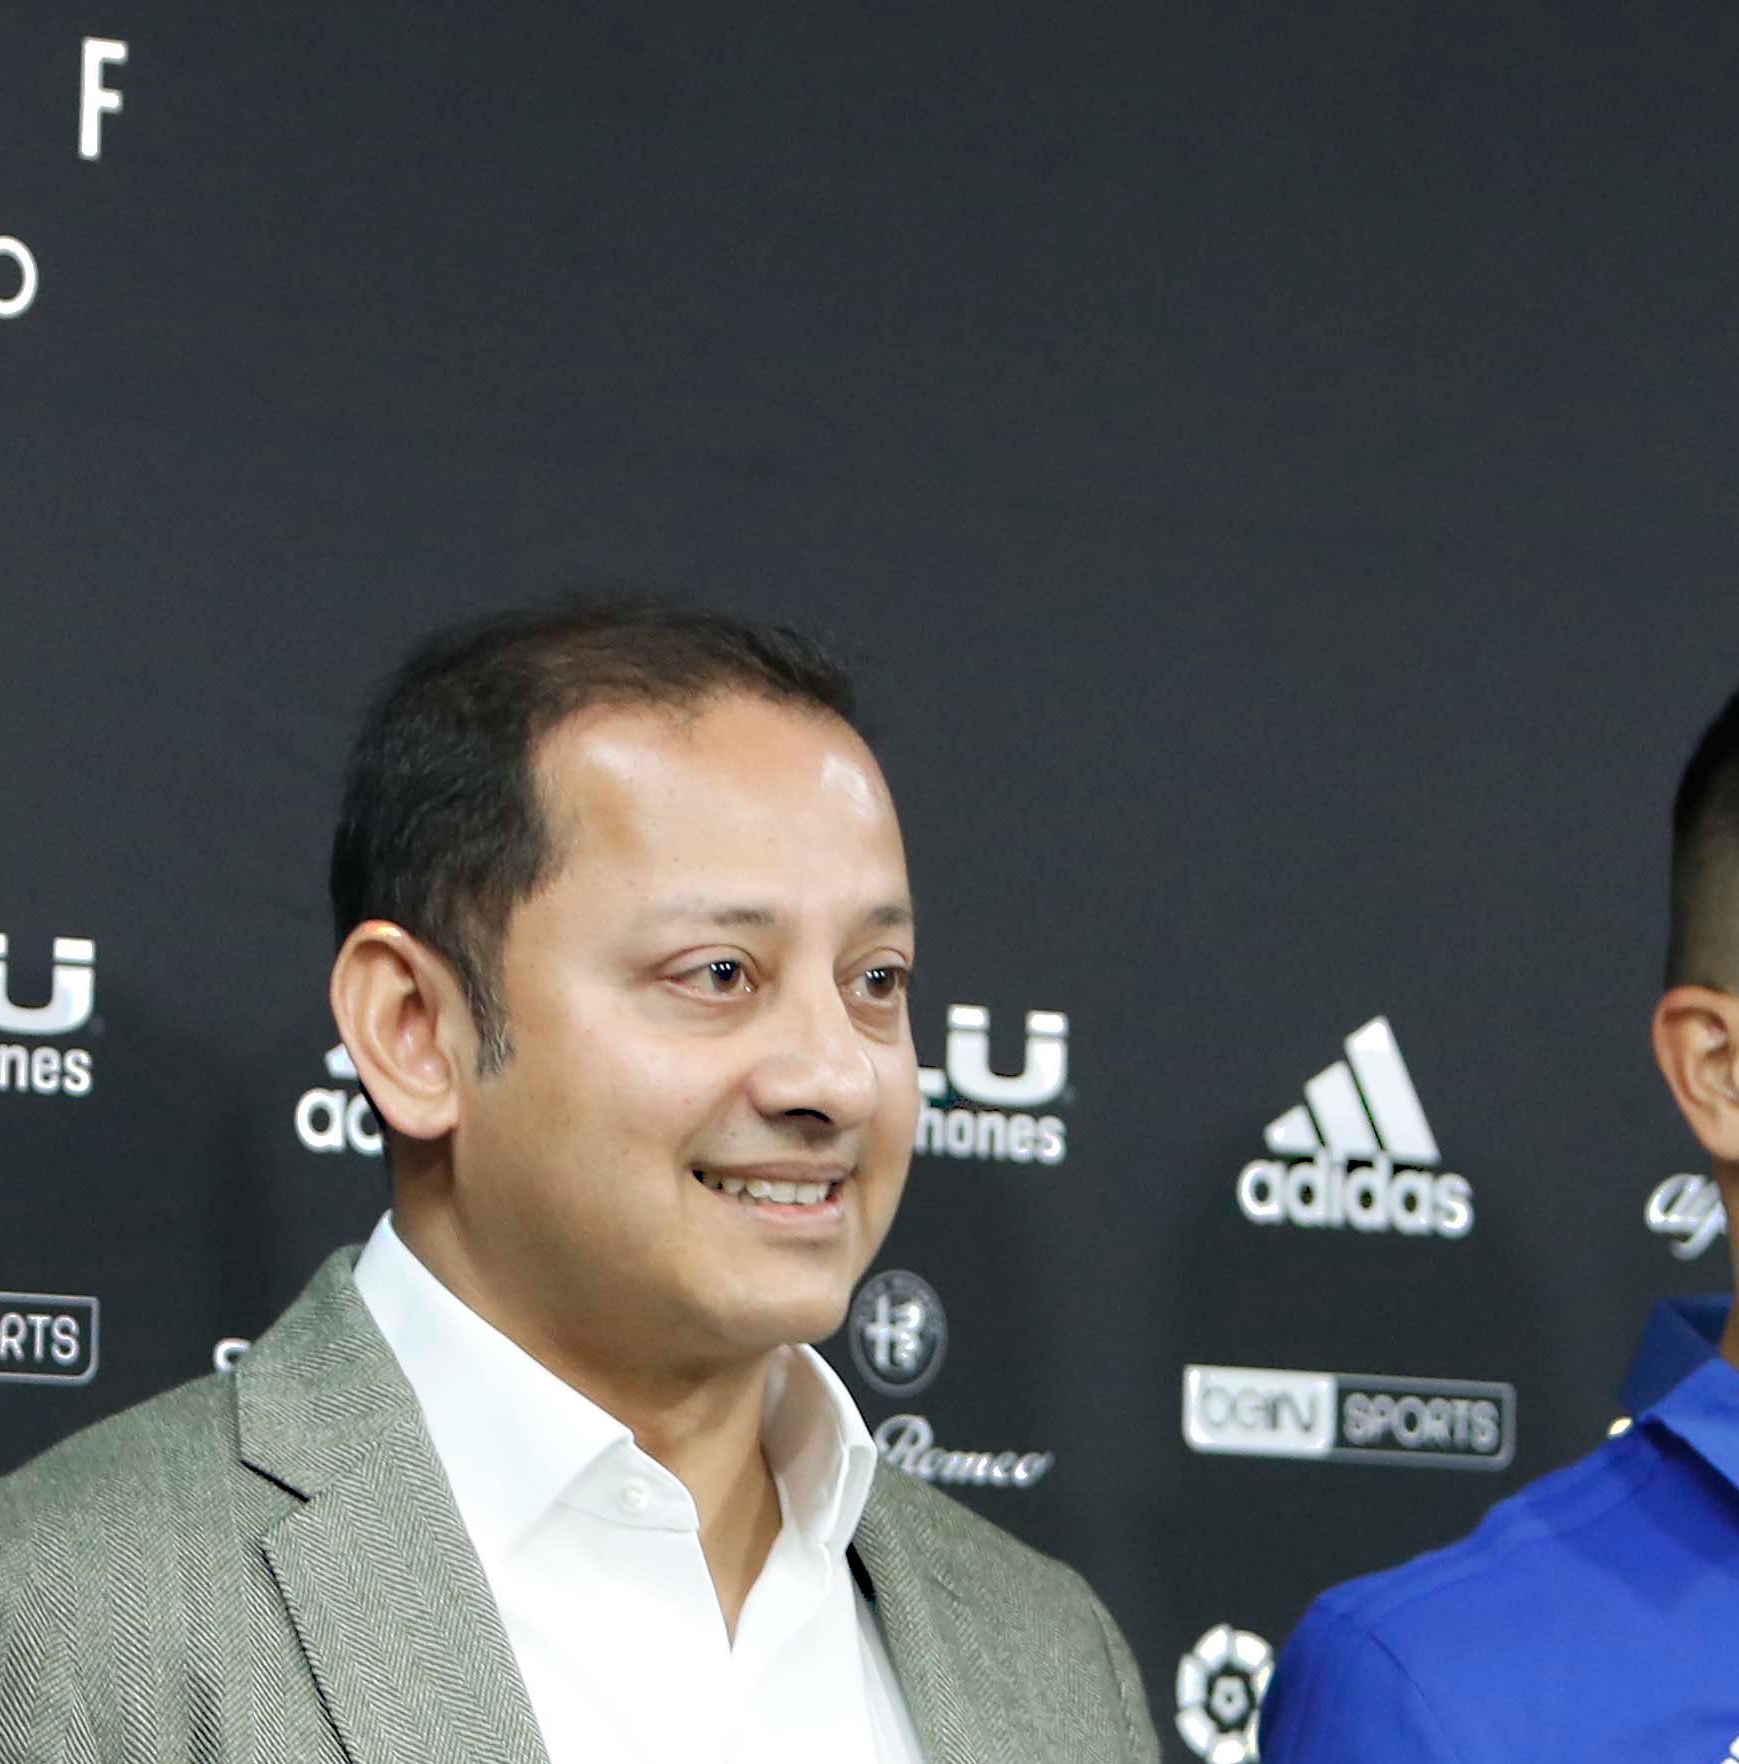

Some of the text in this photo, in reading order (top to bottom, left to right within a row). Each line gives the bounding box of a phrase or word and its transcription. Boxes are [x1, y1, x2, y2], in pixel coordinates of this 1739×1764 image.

[1237, 1150, 1474, 1238] adidas
[872, 1413, 1054, 1488] Romeo
[1342, 1391, 1502, 1451] SPORTS
